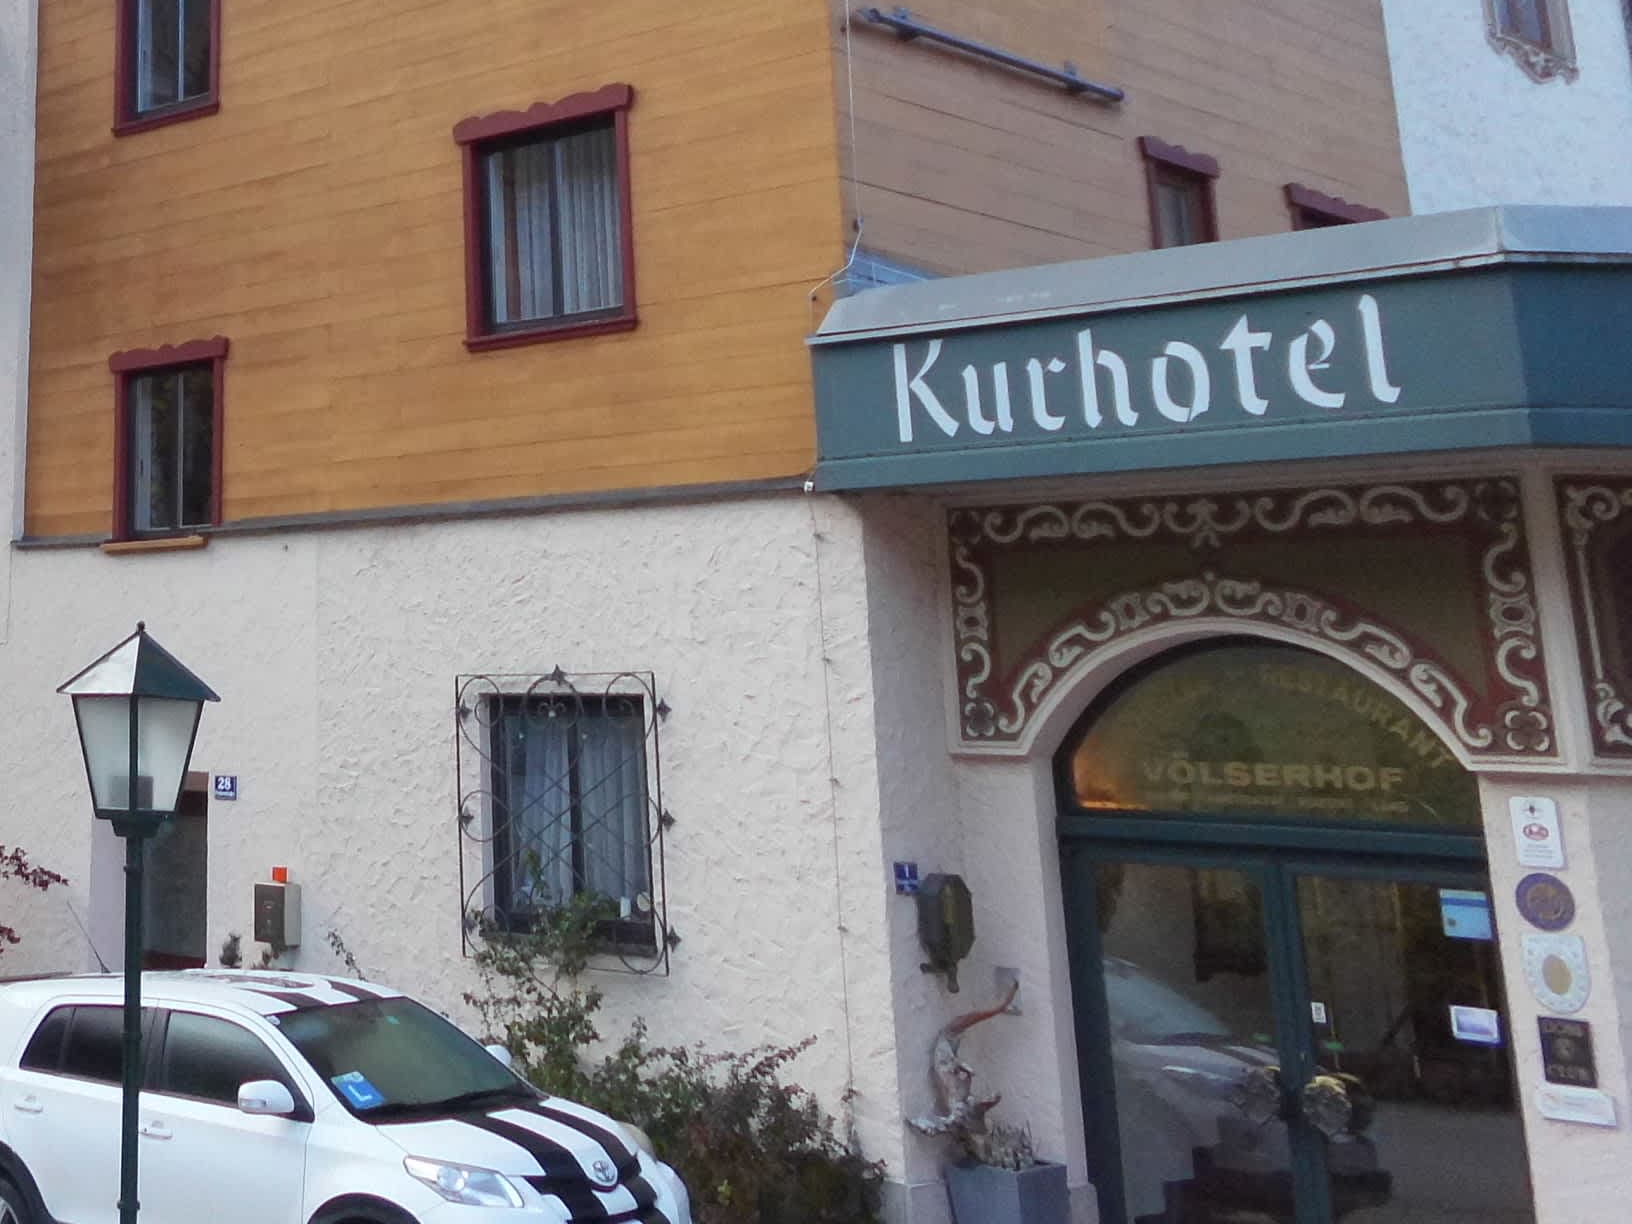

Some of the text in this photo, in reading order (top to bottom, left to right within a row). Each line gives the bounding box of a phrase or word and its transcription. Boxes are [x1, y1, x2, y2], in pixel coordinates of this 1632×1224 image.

[892, 294, 1402, 444] Kurhotel
[217, 777, 231, 790] 28
[1143, 752, 1407, 792] VÖLSERHOF
